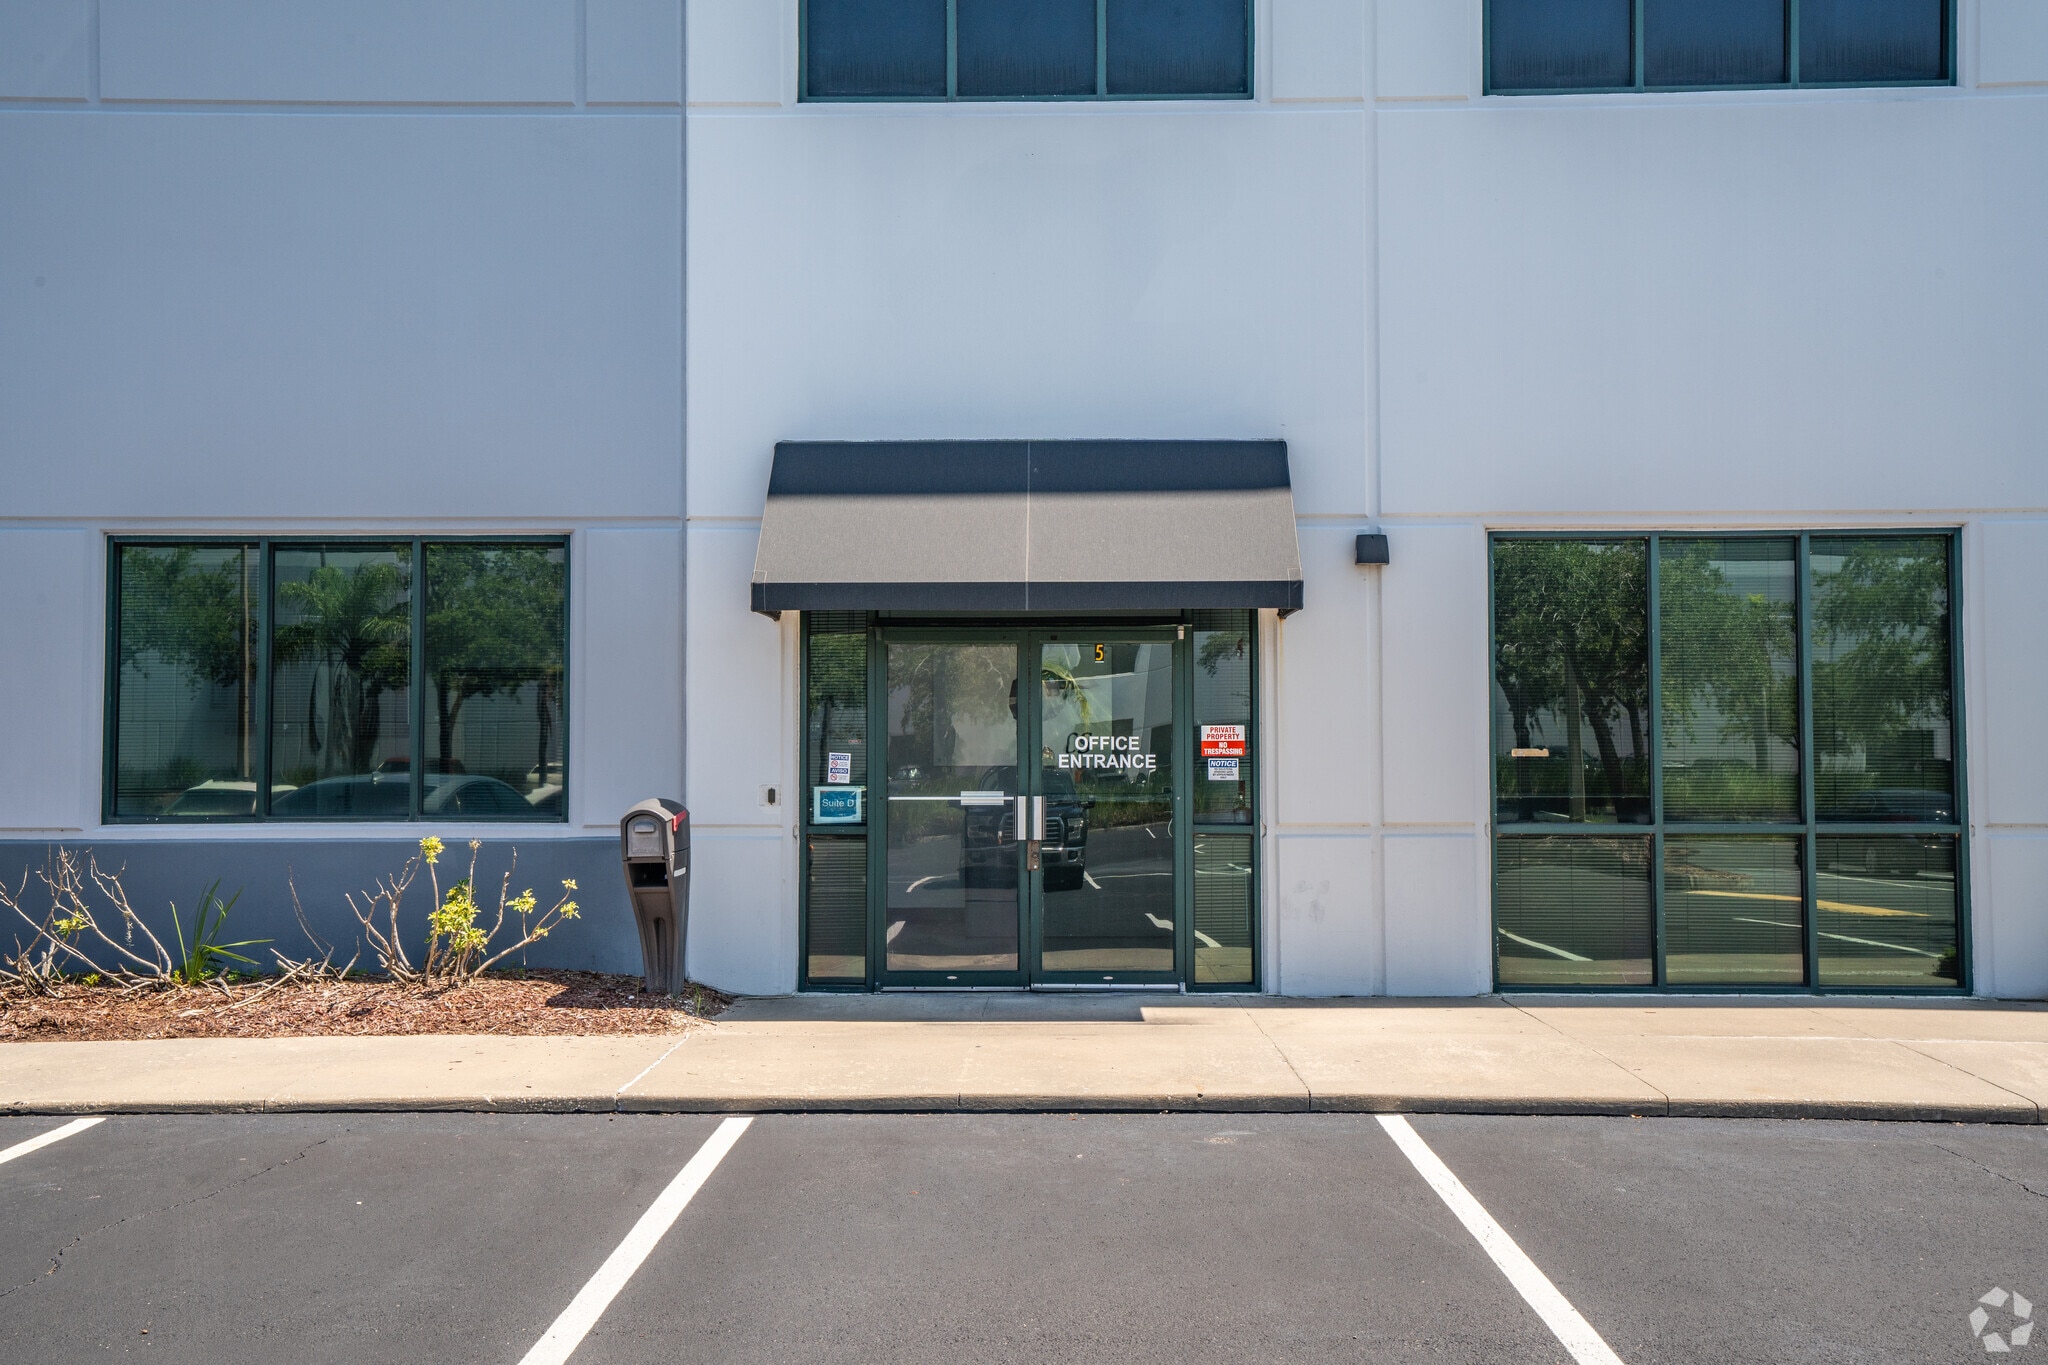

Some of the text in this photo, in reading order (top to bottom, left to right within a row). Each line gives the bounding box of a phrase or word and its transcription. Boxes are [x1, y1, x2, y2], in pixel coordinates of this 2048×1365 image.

[1095, 644, 1104, 660] 5
[1074, 736, 1140, 750] OFFICE
[1058, 754, 1156, 768] ENTRANCE
[822, 799, 854, 807] Suite D
